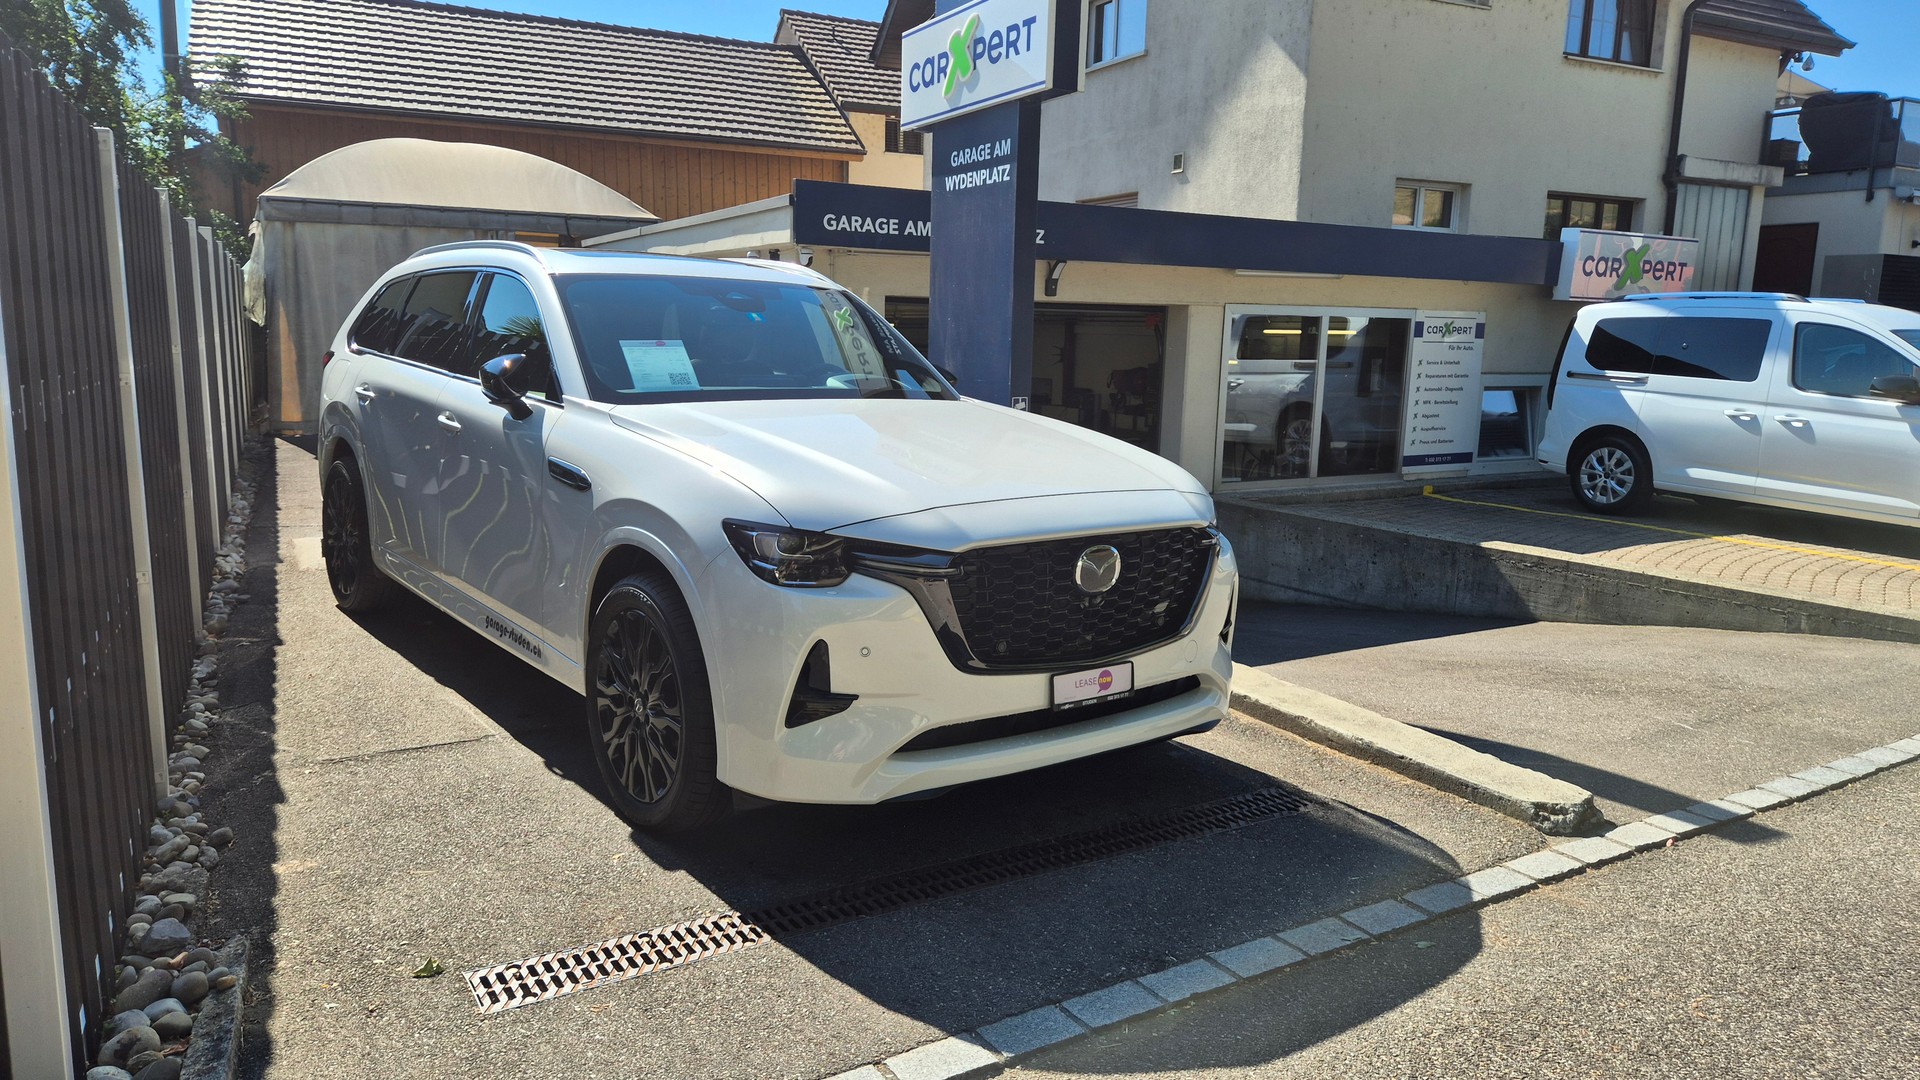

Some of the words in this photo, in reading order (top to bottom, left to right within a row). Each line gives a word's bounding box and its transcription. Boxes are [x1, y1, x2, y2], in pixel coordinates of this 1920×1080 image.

[950, 142, 991, 167] GARAGE
[993, 138, 1011, 157] AM
[945, 164, 1011, 192] WYDENPLATZ
[823, 213, 899, 235] GARAGE
[903, 220, 932, 237] AM
[485, 615, 542, 659] garage-studen.ch
[1074, 677, 1097, 689] LEASE
[1098, 675, 1112, 684] now
